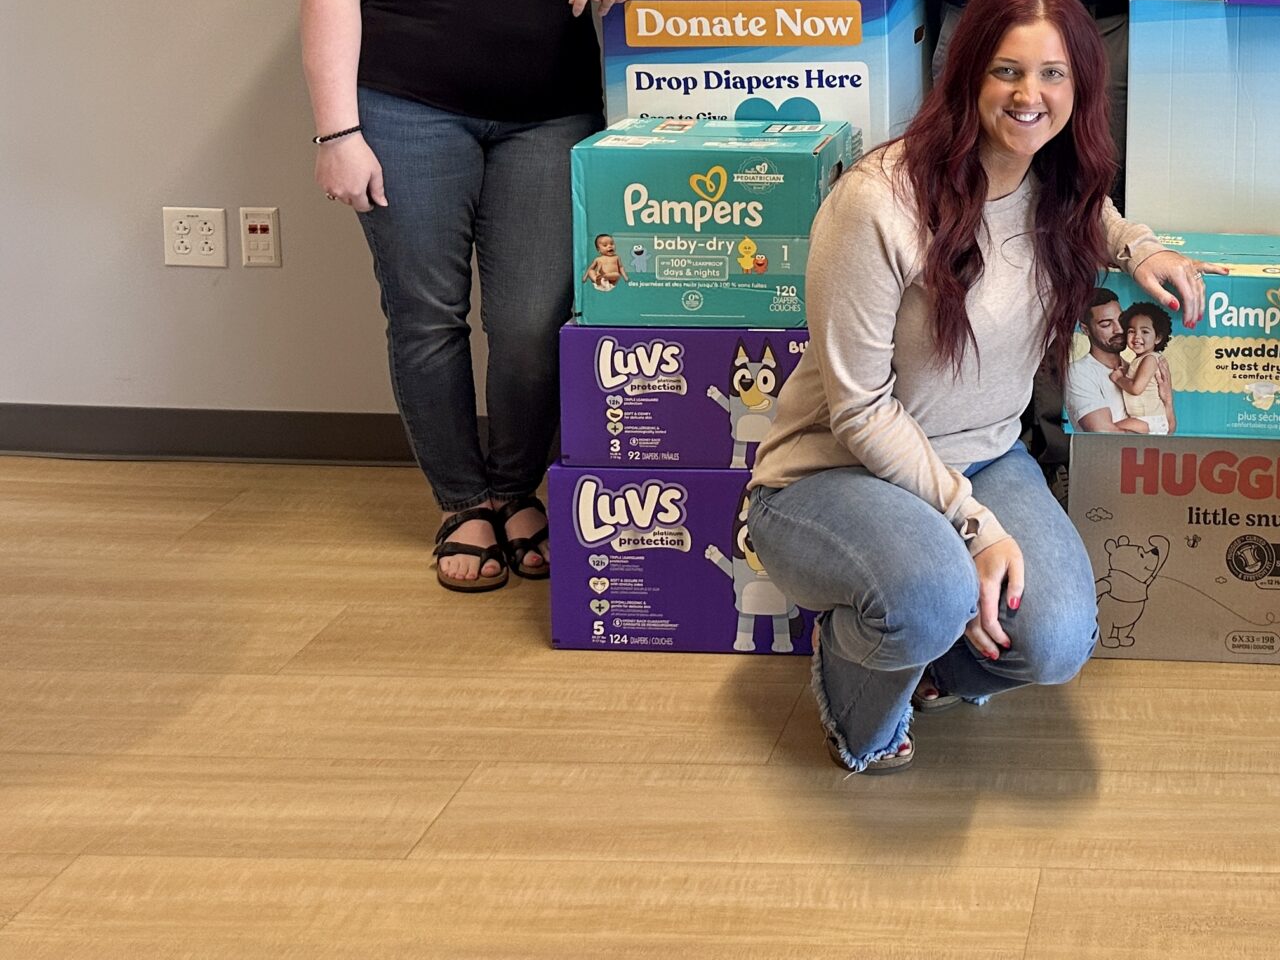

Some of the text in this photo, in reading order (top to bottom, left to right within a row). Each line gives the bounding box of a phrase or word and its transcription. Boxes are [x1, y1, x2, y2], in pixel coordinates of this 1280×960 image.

[636, 8, 853, 38] Donate Now
[635, 70, 863, 95] Drop Diapers Here
[623, 183, 763, 232] Pampers
[653, 235, 735, 255] baby-dry
[781, 245, 789, 261] 1
[663, 269, 684, 278] days
[694, 269, 720, 278] nights
[775, 285, 797, 297] 120
[772, 296, 798, 304] DIAPERS
[769, 304, 800, 312] COUCHES
[599, 339, 680, 389] Luvs
[1231, 361, 1259, 371] best
[1238, 373, 1272, 381] comfort
[630, 383, 682, 392] protection
[1237, 412, 1257, 422] plus
[610, 438, 620, 452] 3
[628, 451, 641, 460] 92
[578, 480, 683, 544] Luvs
[1187, 506, 1240, 526] little
[619, 536, 684, 547] protection
[593, 620, 604, 635] 5
[609, 634, 628, 644] 124
